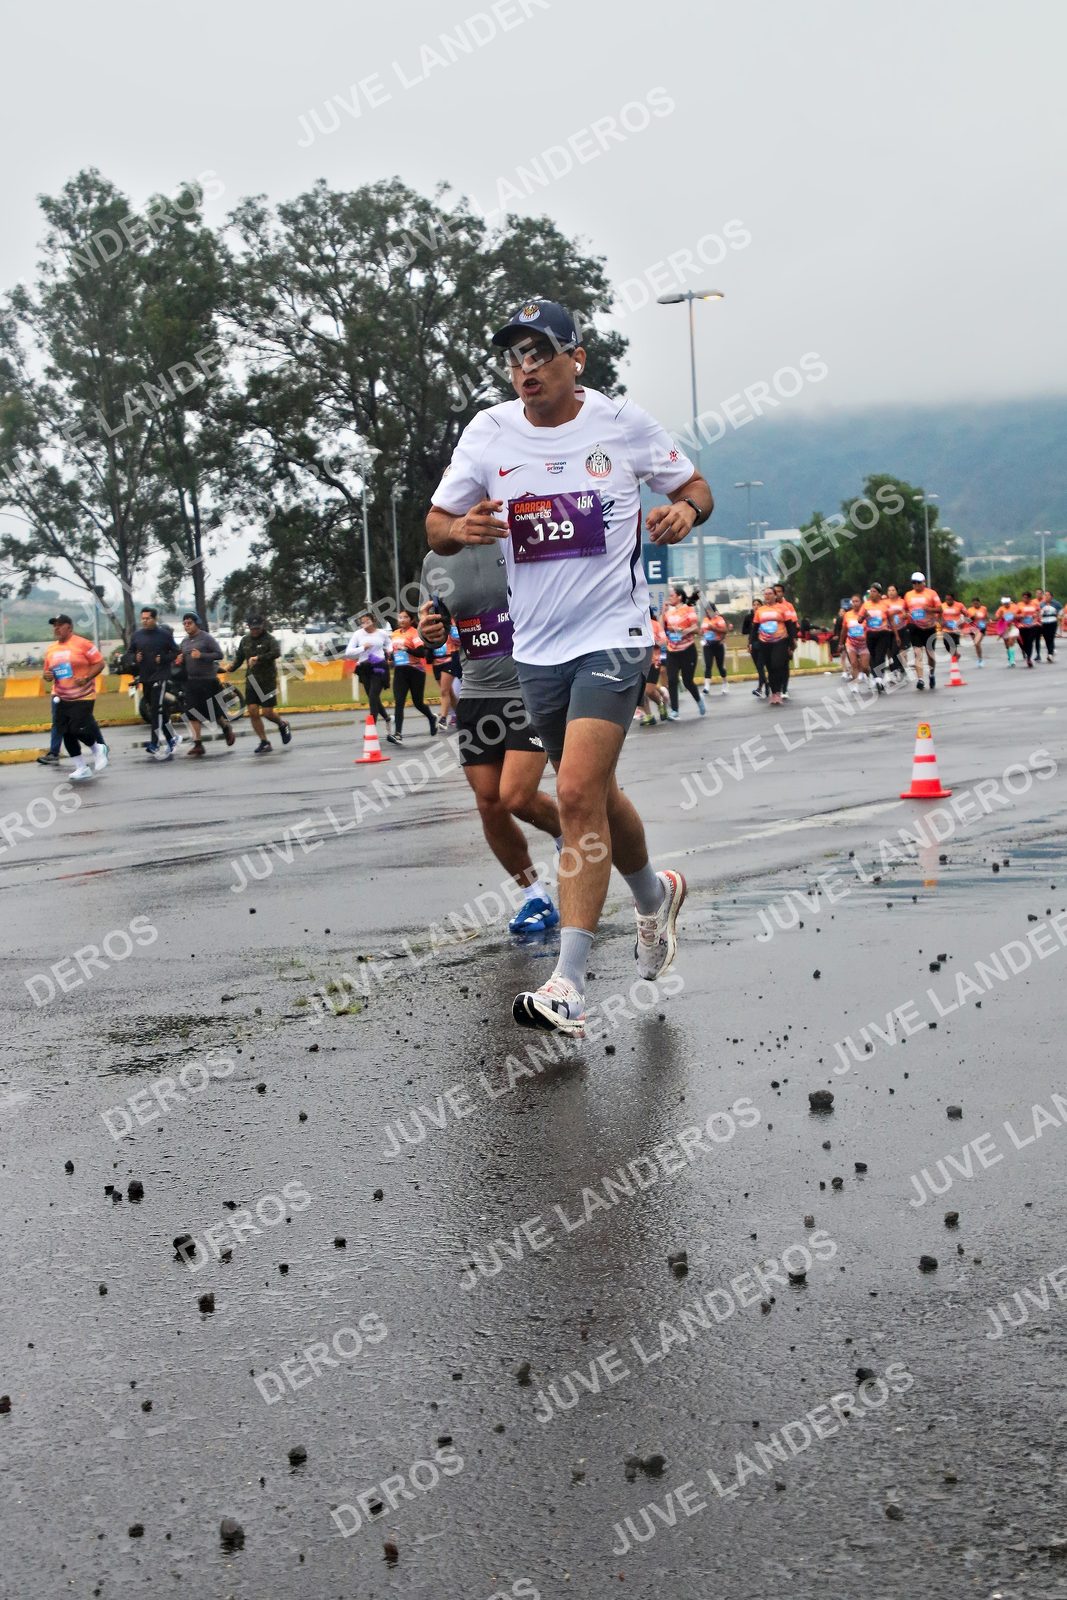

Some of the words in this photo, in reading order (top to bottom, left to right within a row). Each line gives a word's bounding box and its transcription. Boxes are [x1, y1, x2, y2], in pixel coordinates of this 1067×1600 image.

[514, 500, 552, 514] CARRERA
[576, 495, 594, 509] 15K
[534, 520, 575, 541] 129
[648, 560, 662, 579] E
[472, 631, 499, 647] 480
